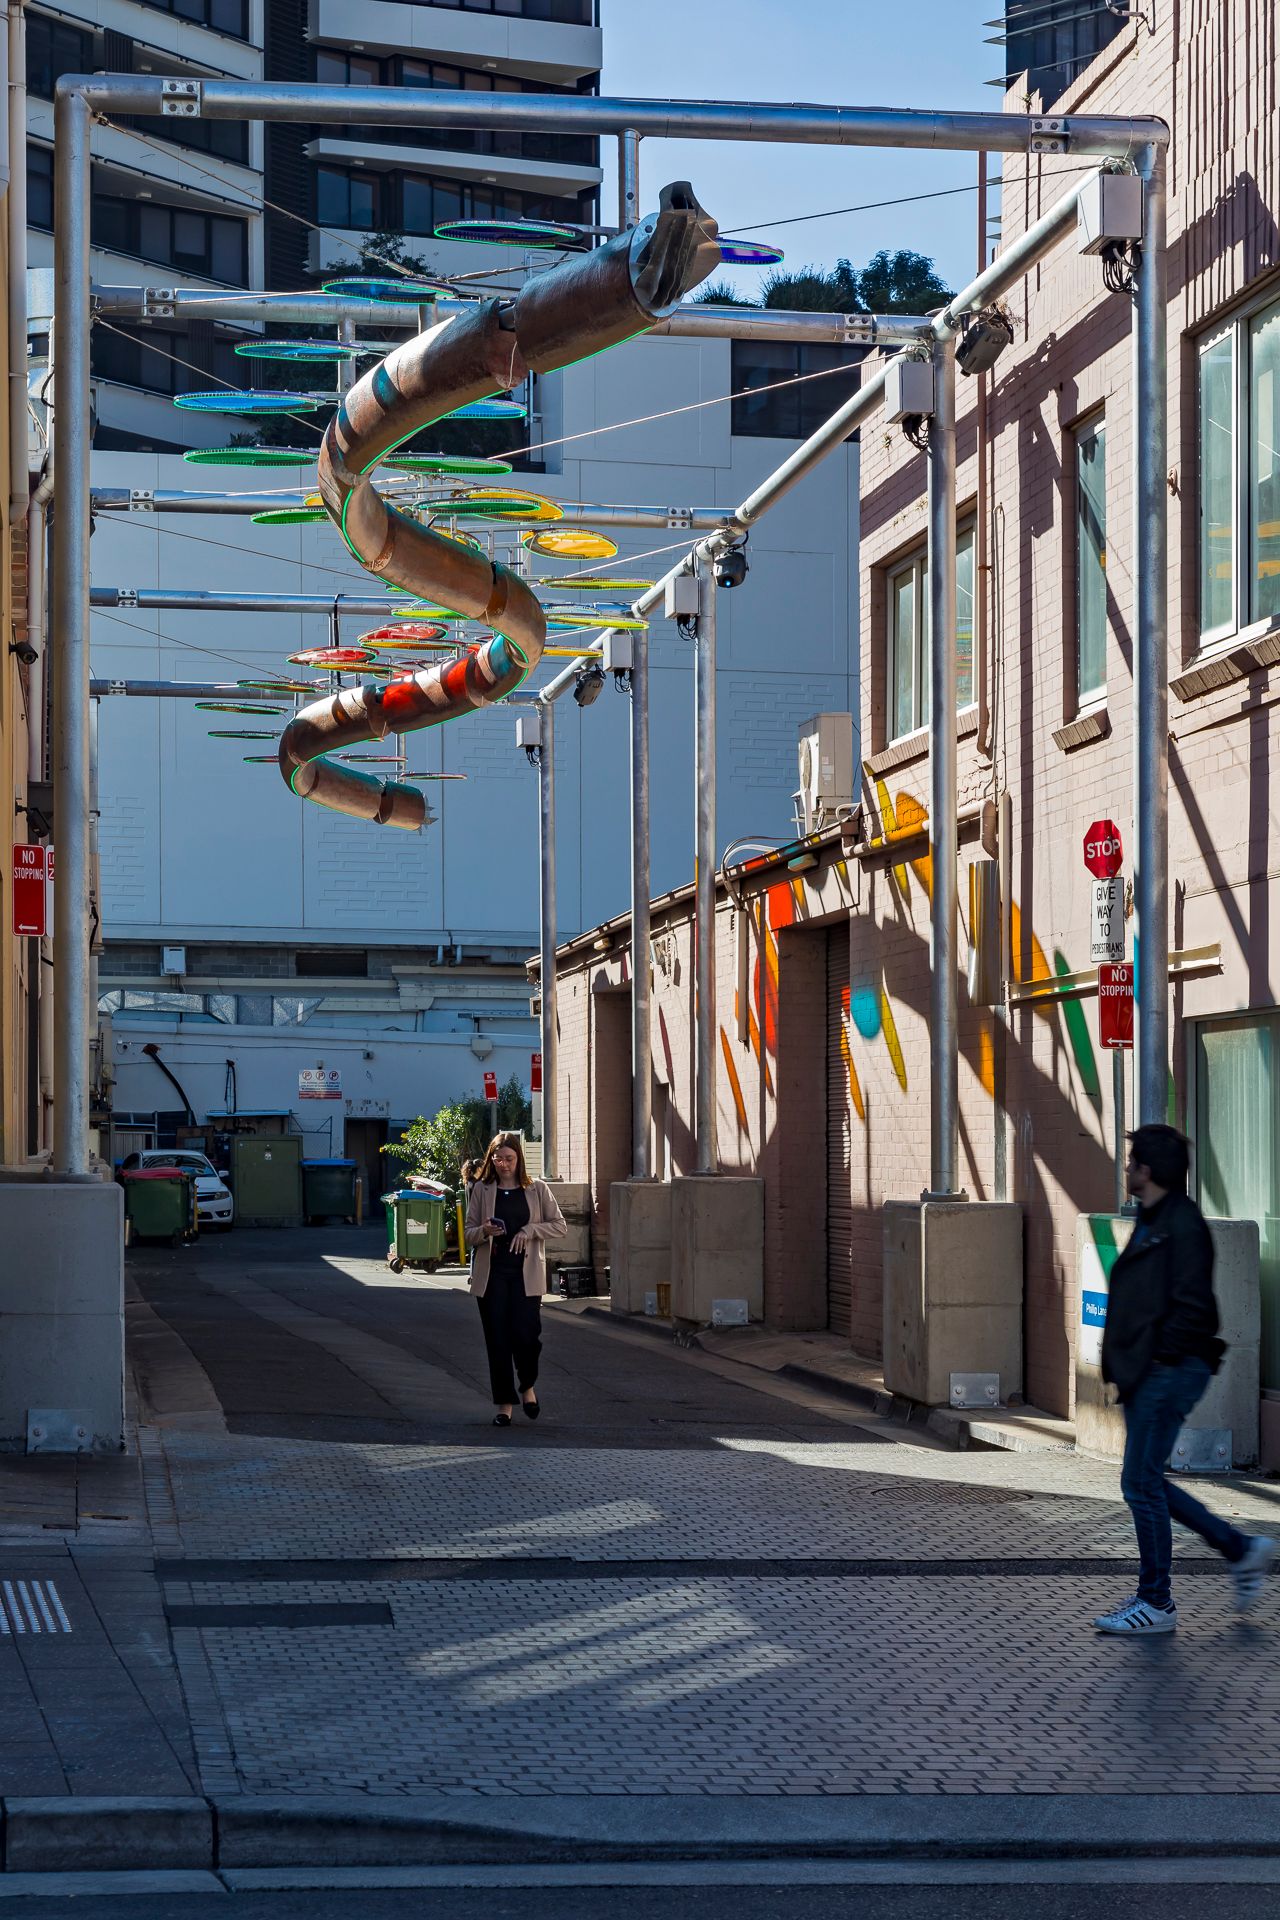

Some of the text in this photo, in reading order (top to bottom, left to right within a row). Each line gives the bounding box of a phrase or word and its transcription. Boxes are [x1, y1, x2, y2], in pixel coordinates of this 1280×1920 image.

[1086, 839, 1121, 859] STOP
[22, 850, 35, 865] NO
[14, 867, 43, 880] STOPPING
[1096, 886, 1116, 901] GIVE
[1097, 904, 1114, 919] WAY
[1099, 923, 1111, 937] TO
[1092, 942, 1123, 955] PEDESTRIANS
[1111, 968, 1127, 982] NO
[1101, 985, 1134, 997] STOPPIN
